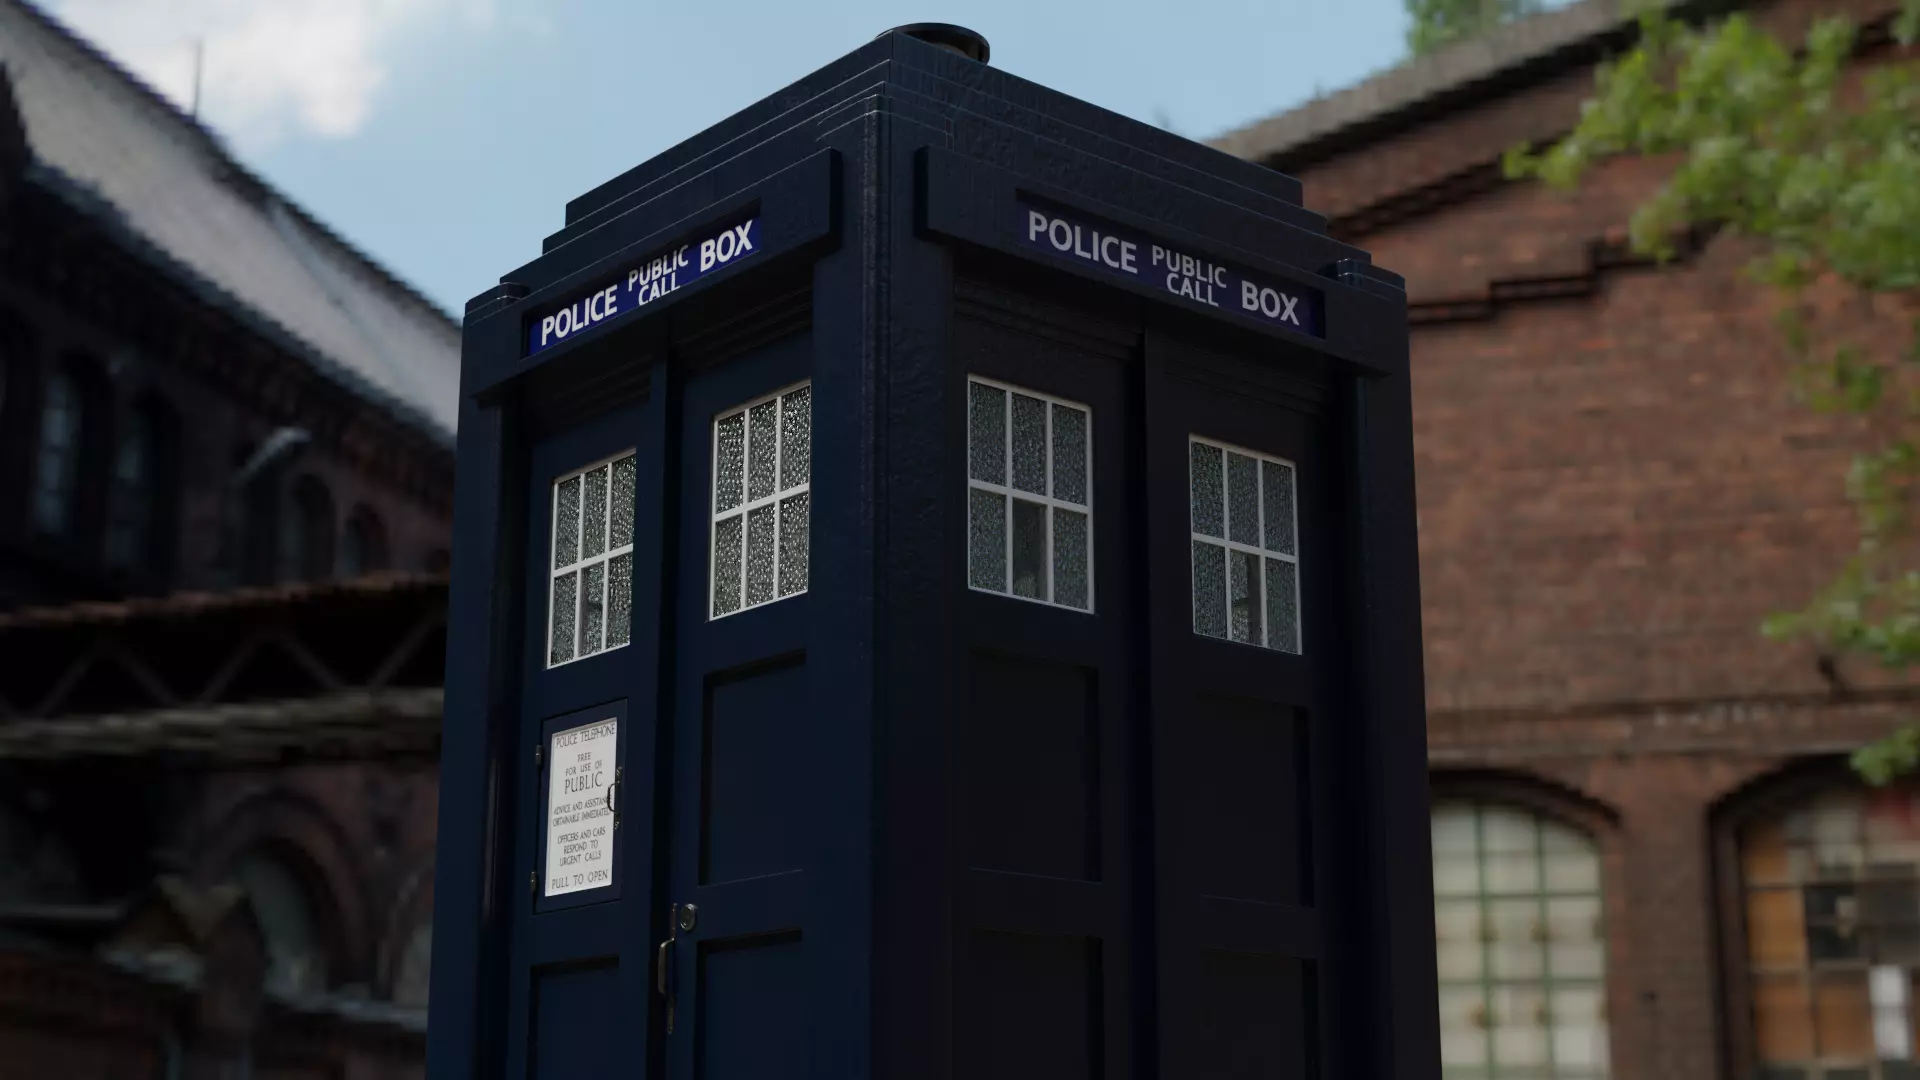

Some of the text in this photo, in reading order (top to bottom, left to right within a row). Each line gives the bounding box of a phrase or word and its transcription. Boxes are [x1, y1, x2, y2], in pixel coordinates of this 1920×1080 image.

[1029, 210, 1300, 326] POLICE PUBLIC CALL BOX
[541, 219, 753, 346] POLICE PUBLIC CALL BOX
[556, 723, 616, 748] POLICE TELEPHONE
[577, 752, 592, 762] FREE
[565, 760, 602, 776] FOR USE OF
[565, 771, 603, 794] PUBLIC
[554, 803, 571, 815] ADVICE
[572, 801, 583, 811] AND
[557, 826, 606, 844] OFFICERS AND CARS
[564, 839, 599, 855] RESPOND TO
[559, 850, 601, 867] URGENT CALLS
[551, 869, 608, 889] PULL TO OPEN
